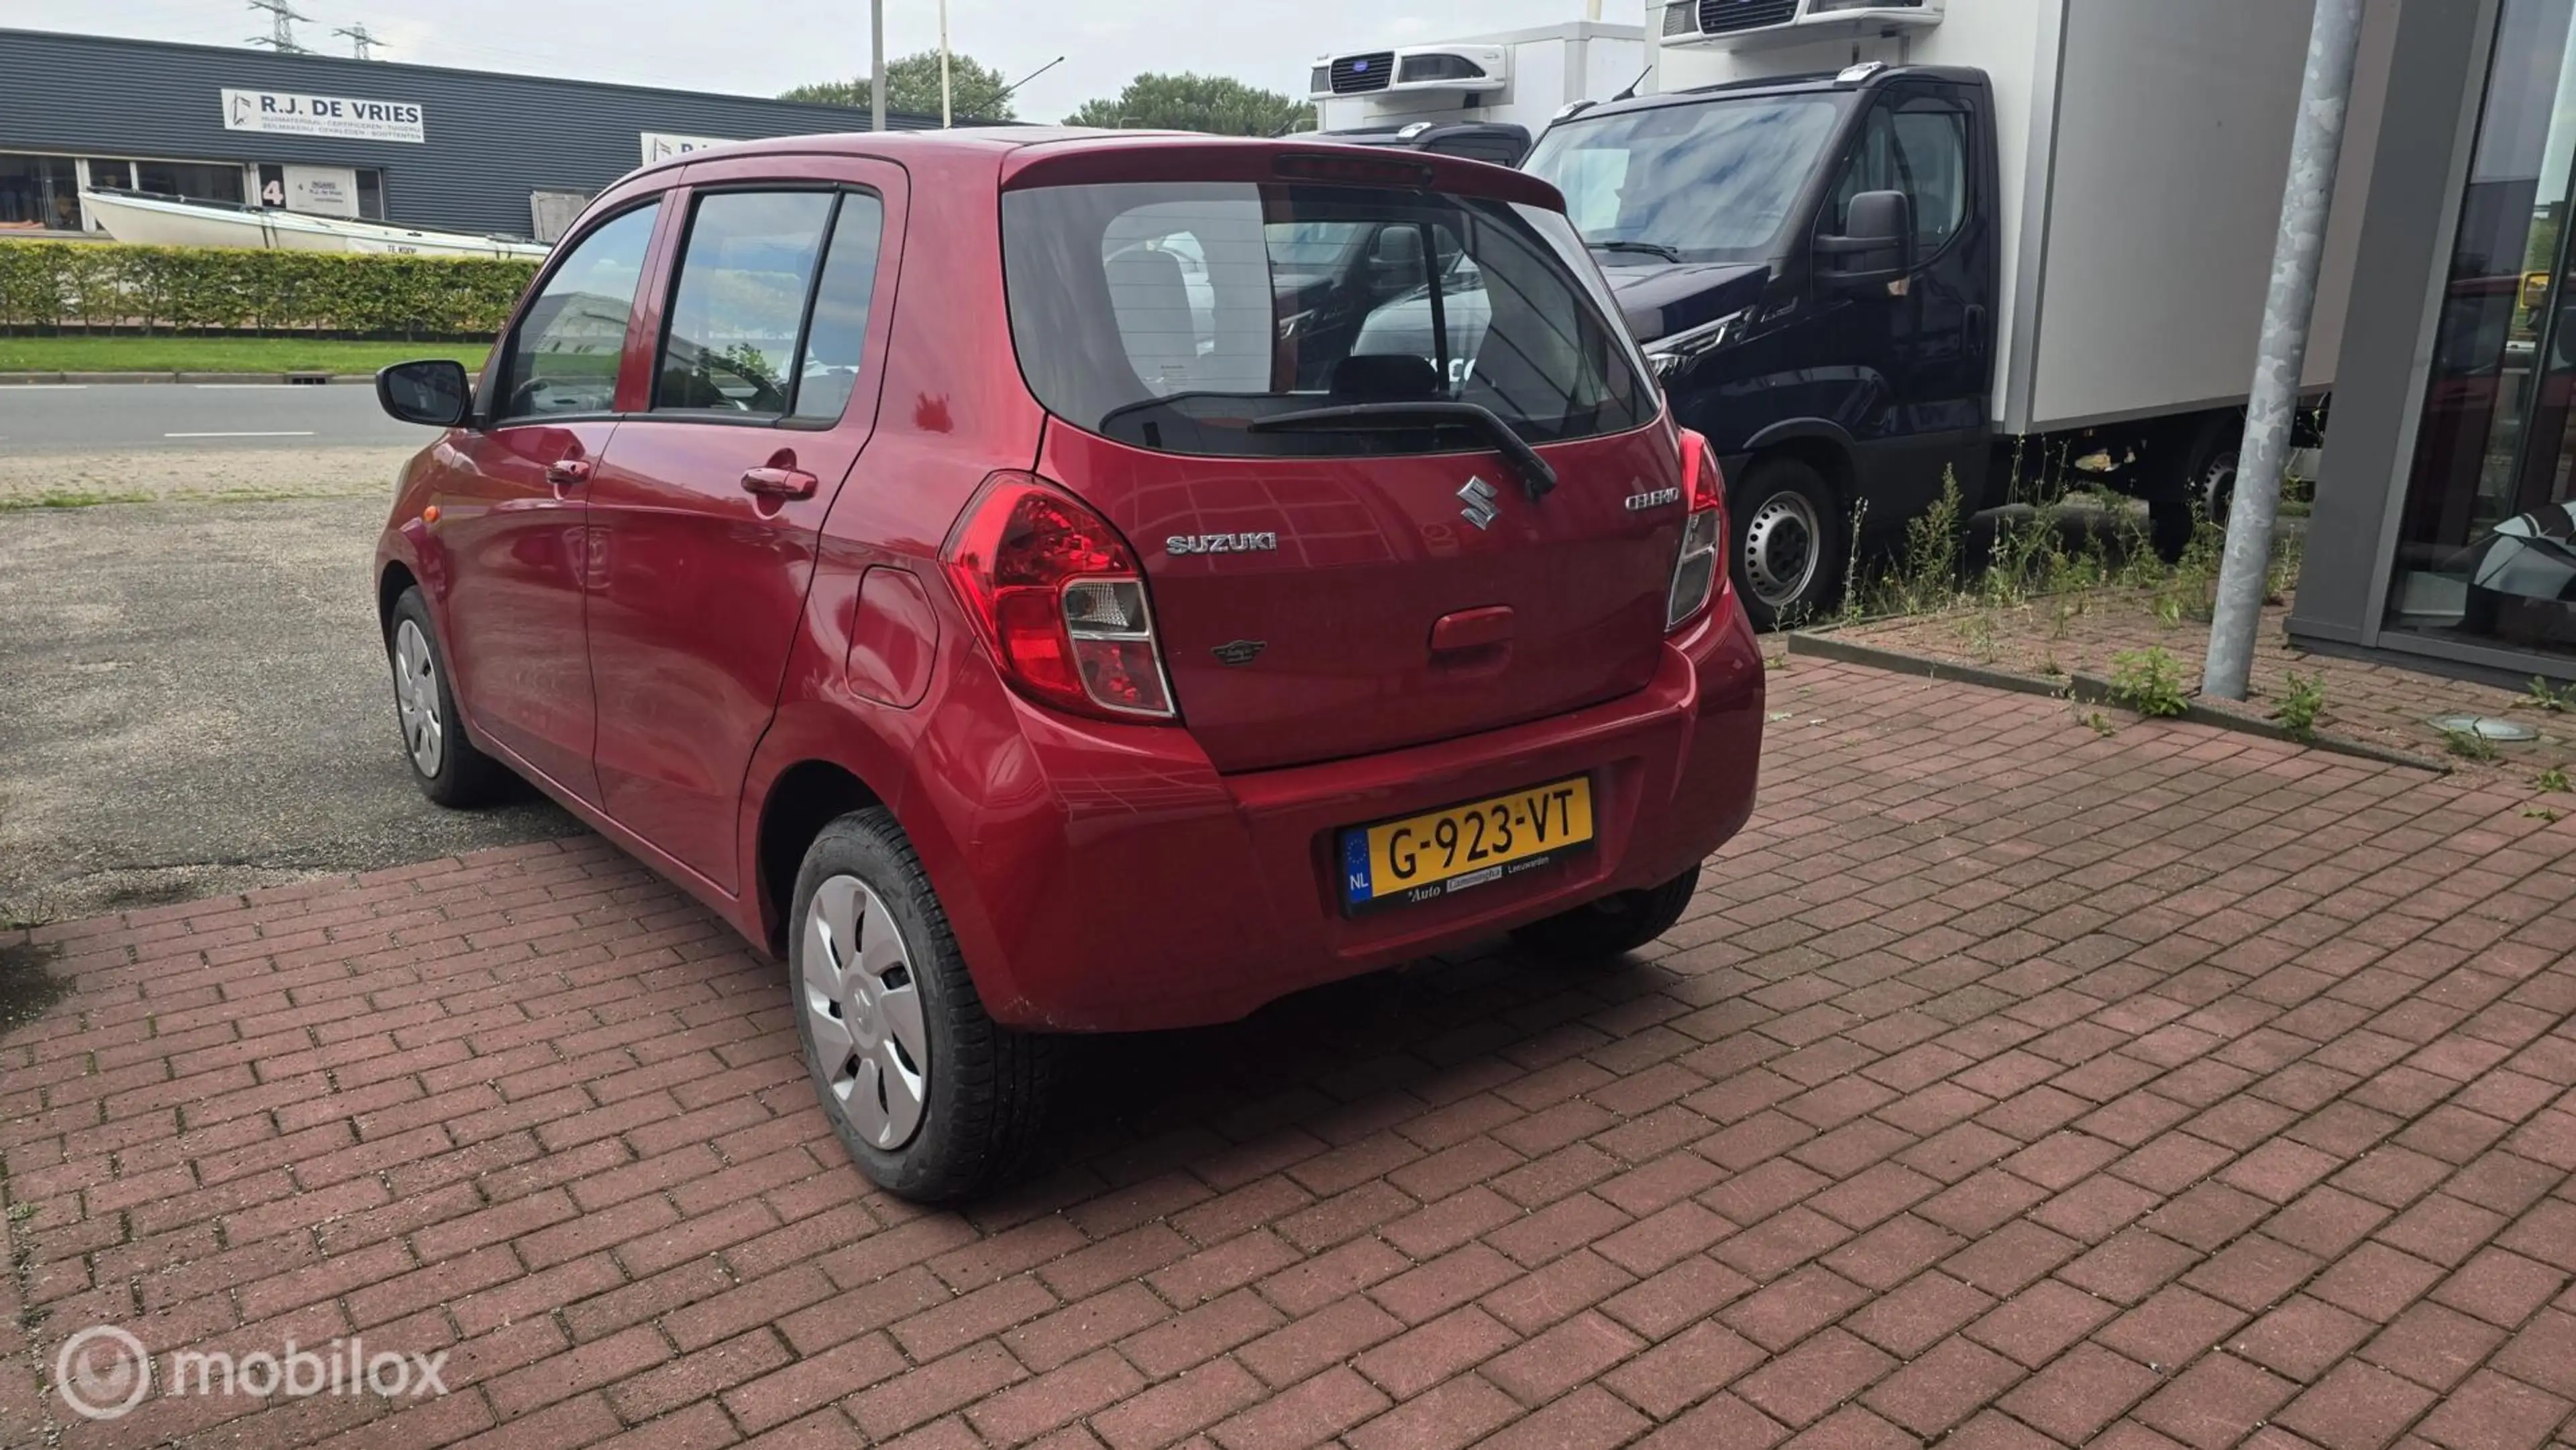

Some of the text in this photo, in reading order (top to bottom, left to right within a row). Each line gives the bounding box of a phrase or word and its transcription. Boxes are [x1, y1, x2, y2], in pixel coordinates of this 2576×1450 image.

[260, 95, 419, 123] R.J. DE VRIES
[263, 180, 284, 205] 4
[1166, 533, 1277, 555] SUZUKI
[1389, 789, 1574, 880] G-923-VT
[1350, 873, 1369, 891] NL
